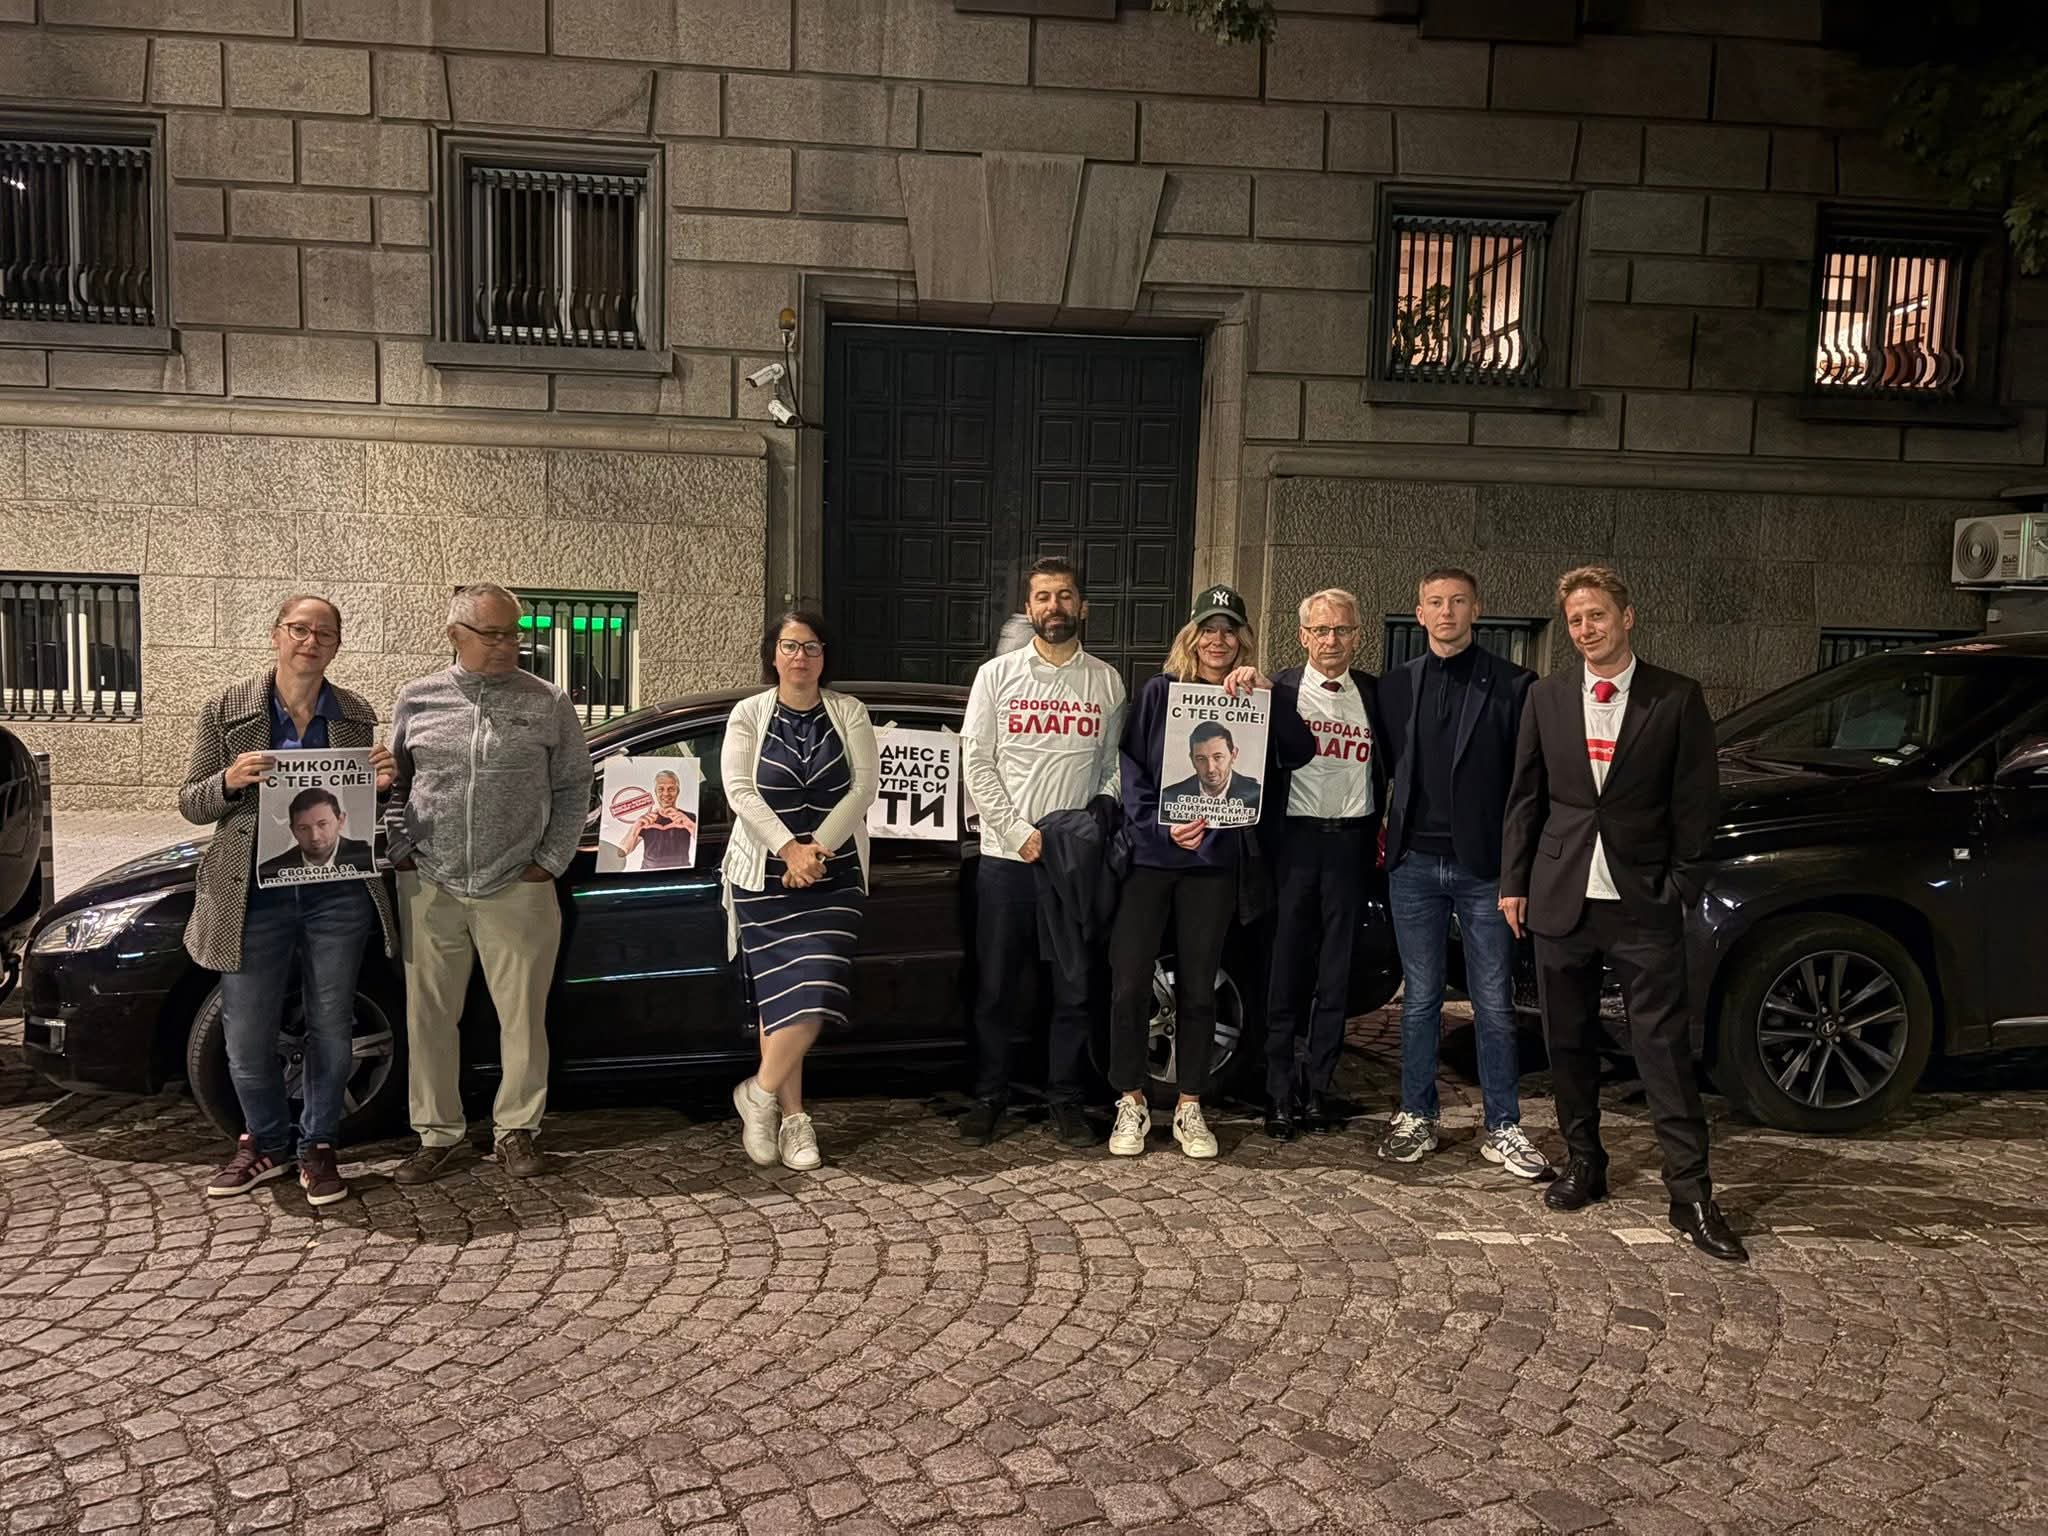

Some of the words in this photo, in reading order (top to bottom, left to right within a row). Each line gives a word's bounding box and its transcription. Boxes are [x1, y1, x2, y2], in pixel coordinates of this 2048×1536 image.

[1212, 591, 1229, 606] NY
[1009, 699, 1081, 714] СВОБОДА
[1084, 702, 1102, 714] ЗА
[1182, 693, 1256, 711] НИКОЛА,
[1171, 707, 1182, 718] С
[1188, 708, 1219, 720] ТЕБ
[1225, 710, 1265, 725] СМЕ!
[1008, 714, 1101, 738] БЛАГО!
[1303, 719, 1361, 738] ВОБОДА
[879, 744, 934, 762] ДНЕС
[940, 749, 950, 763] Е
[1314, 735, 1370, 762] АГО
[276, 759, 362, 773] НИКОЛА,
[880, 760, 950, 780] БЛАГО
[265, 776, 278, 788] С
[285, 775, 323, 788] ТЕБ
[329, 773, 372, 786] СМЕ!
[879, 777, 918, 792] УТРЕ
[922, 781, 947, 794] СИ
[878, 790, 945, 828] ТИ
[1165, 802, 1256, 816] ПОЛИТИЧЕСКИТЕ
[1177, 795, 1228, 807] СВОБОДА
[1229, 797, 1244, 808] ЗА
[278, 865, 338, 877] СВОБОДА
[340, 864, 357, 873] ЗА
